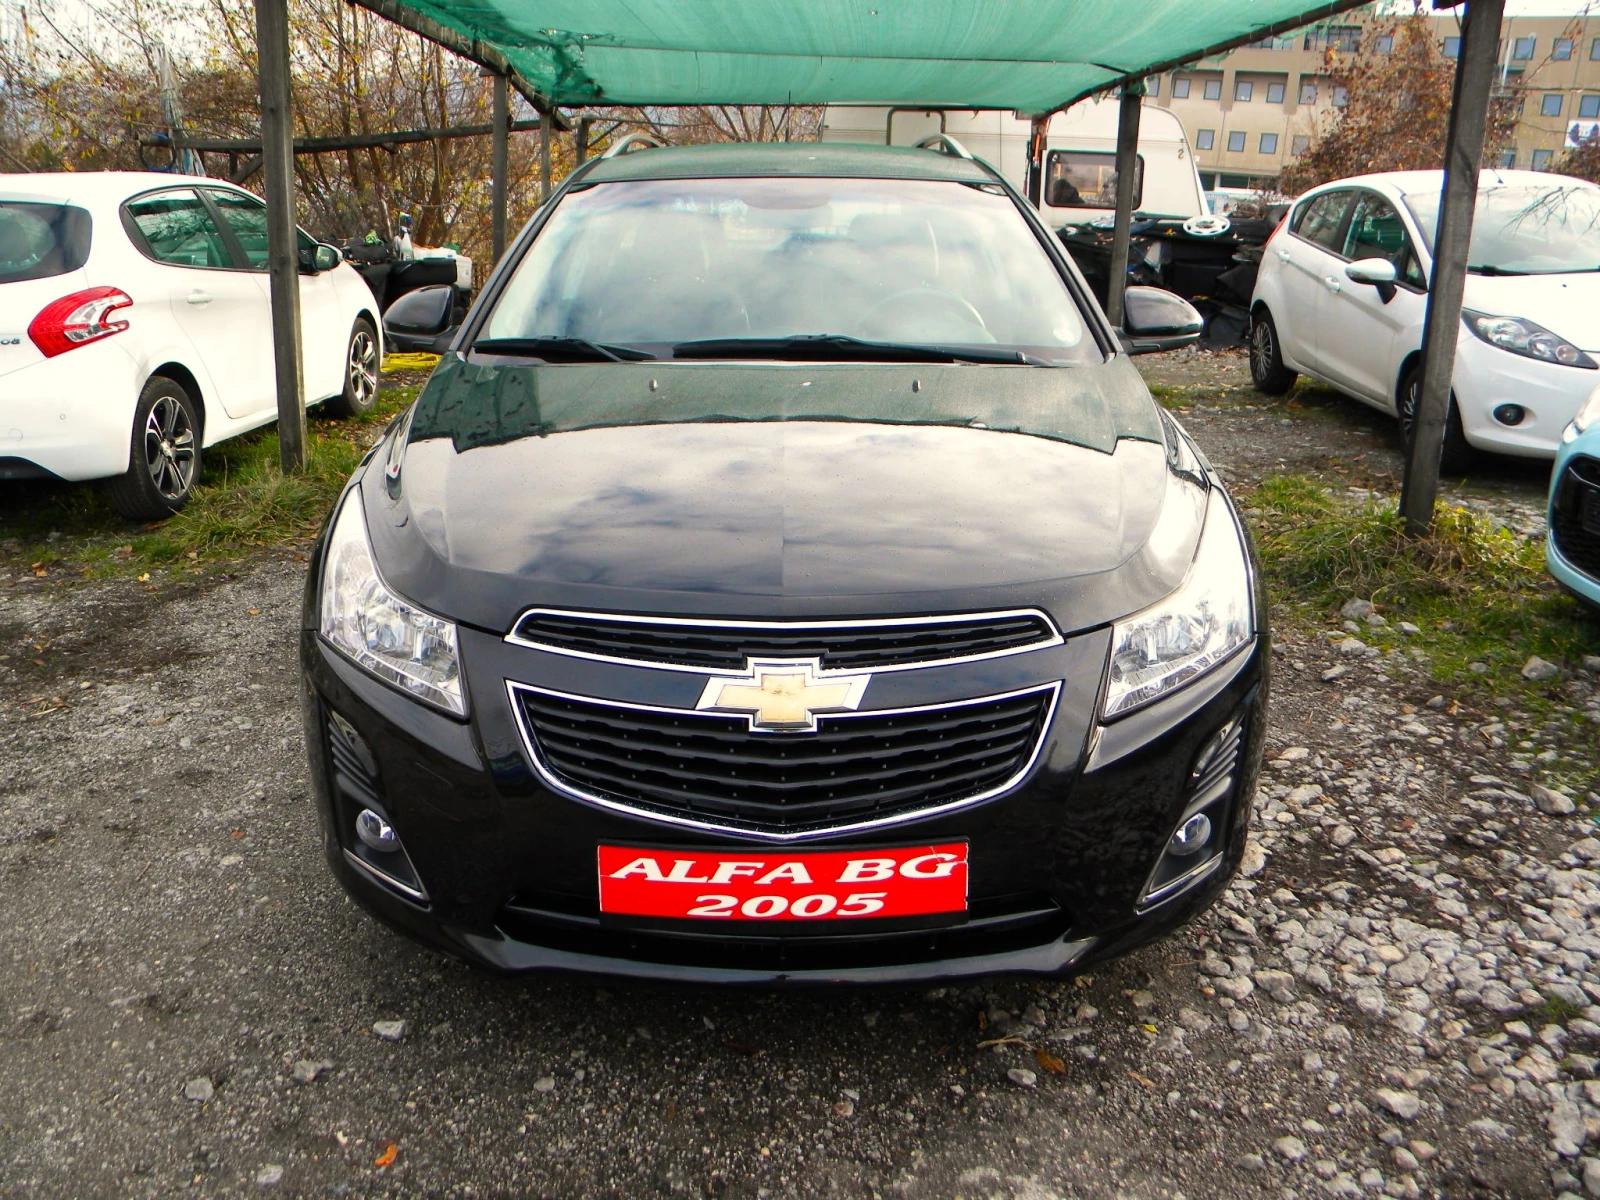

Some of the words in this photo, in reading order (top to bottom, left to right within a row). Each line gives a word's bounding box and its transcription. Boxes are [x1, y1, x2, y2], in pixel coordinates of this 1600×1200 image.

[609, 857, 814, 885] ALFA
[835, 852, 960, 884] BG
[686, 892, 888, 918] 2005
